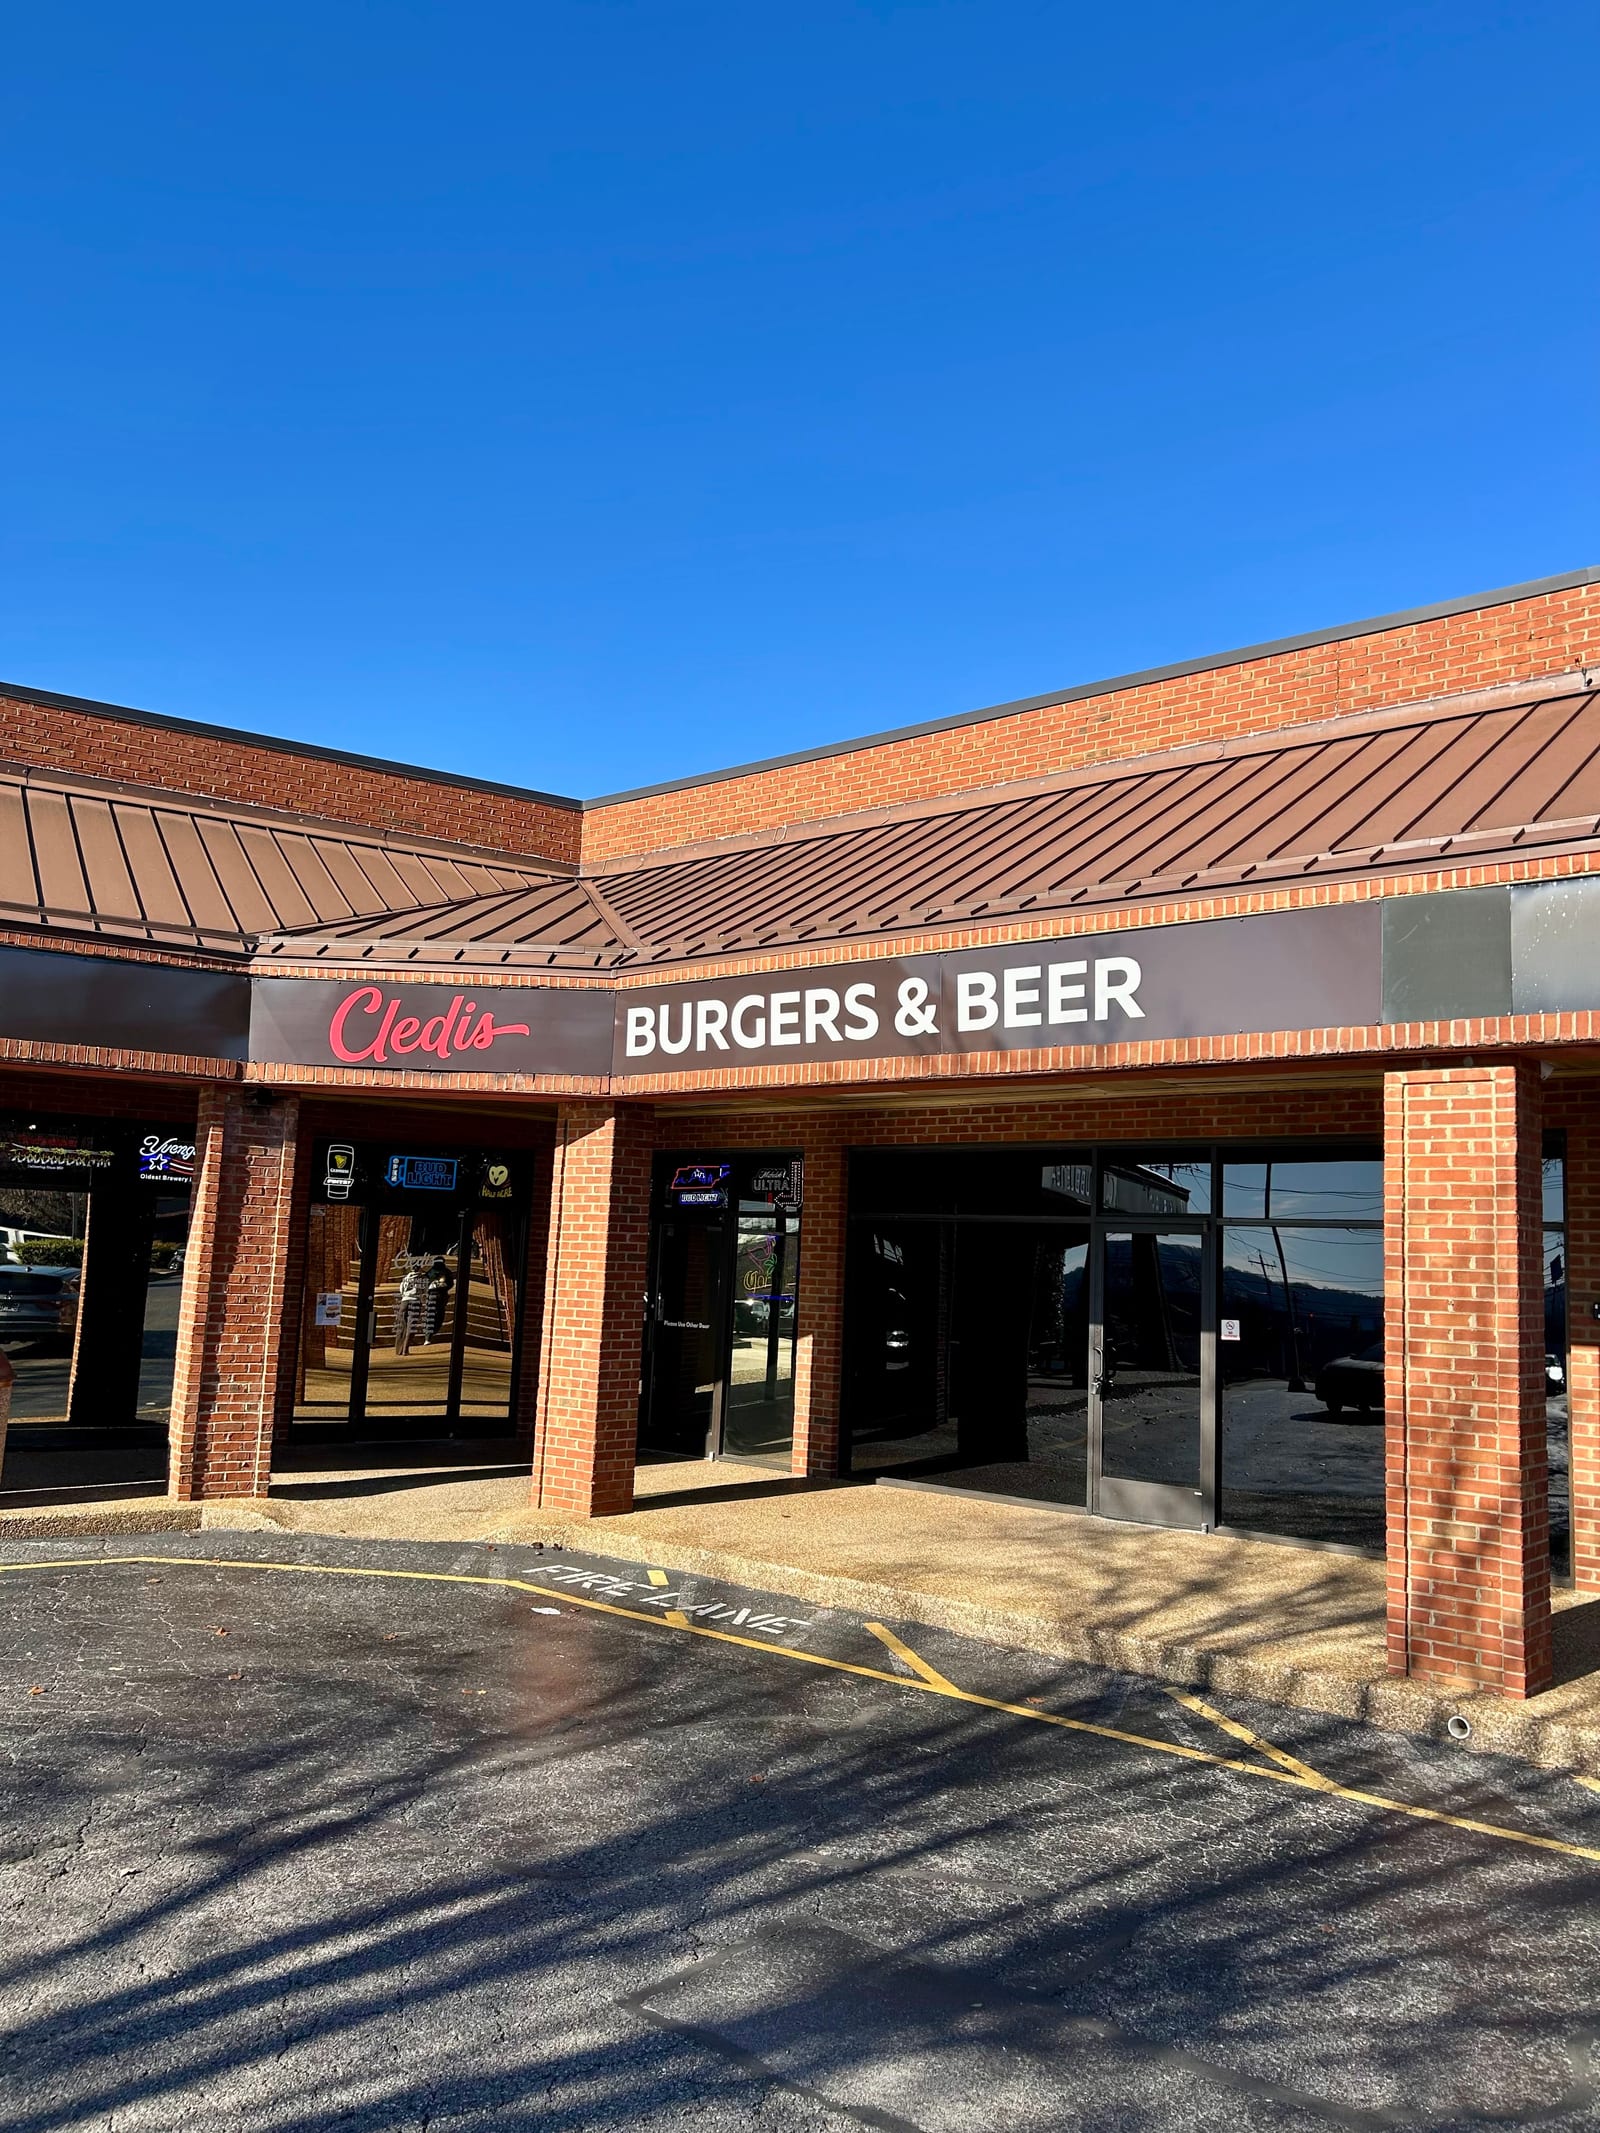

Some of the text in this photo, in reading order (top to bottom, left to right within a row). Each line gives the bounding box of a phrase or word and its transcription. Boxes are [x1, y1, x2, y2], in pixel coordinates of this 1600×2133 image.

[625, 956, 1146, 1057] BURGERS & BEER
[329, 986, 530, 1063] Cledis
[139, 1135, 196, 1160] Yueng
[407, 1171, 452, 1186] LIGHT
[415, 1161, 447, 1174] BUD
[753, 1179, 790, 1191] ULTRA
[522, 1564, 659, 1597] FIRE
